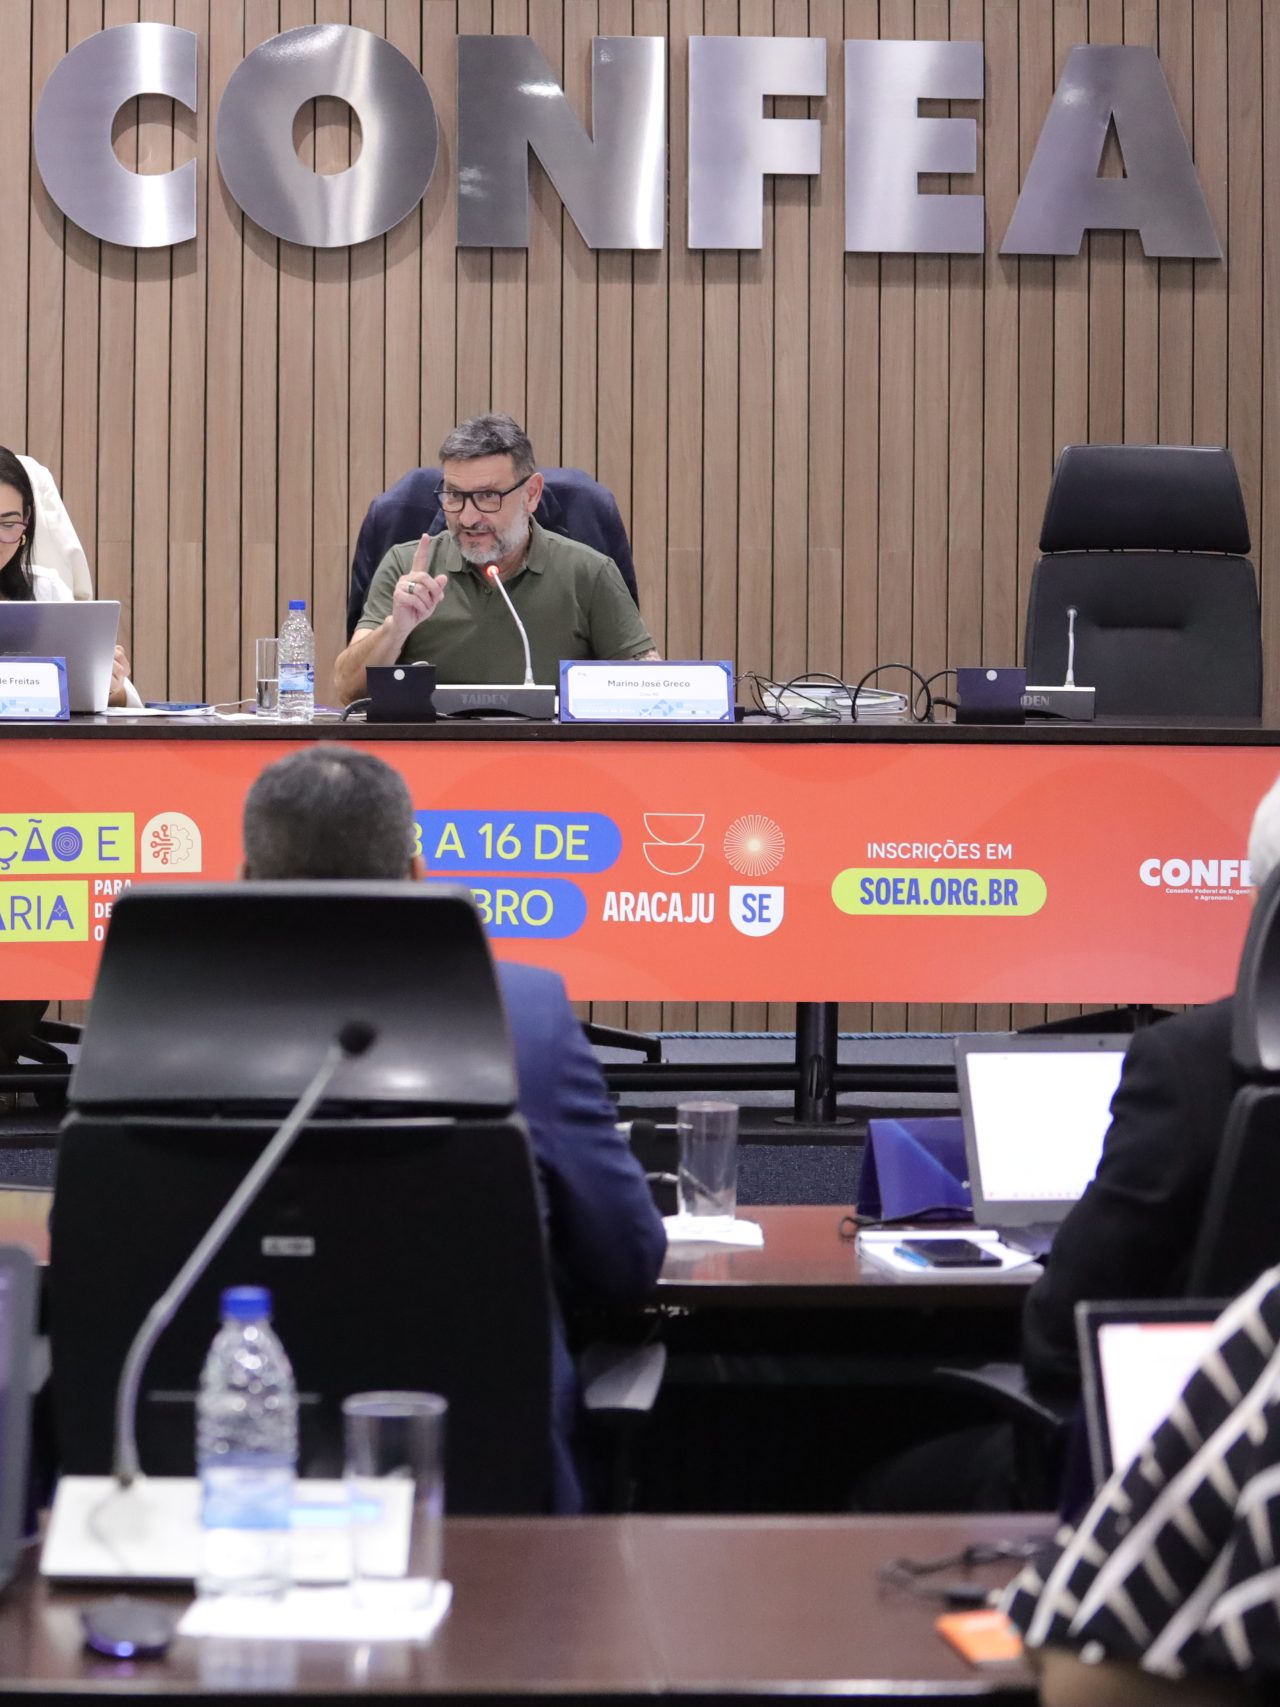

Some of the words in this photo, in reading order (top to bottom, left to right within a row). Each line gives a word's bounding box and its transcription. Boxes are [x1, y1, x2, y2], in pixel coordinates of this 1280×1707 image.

[34, 22, 1223, 258] CONFEA
[9, 677, 40, 685] Freitas
[607, 680, 639, 688] Marino
[641, 679, 661, 688] José
[663, 680, 691, 688] Greco
[461, 693, 511, 706] TAIDEN
[97, 826, 120, 861] E
[434, 822, 466, 859] A
[478, 823, 522, 860] 16
[534, 824, 590, 861] DE
[867, 839, 981, 862] INSCRIÇÕES
[986, 843, 1013, 860] EM
[859, 877, 1019, 906] SOEA.ORG.BR
[602, 891, 715, 924] ARACAJU
[741, 893, 772, 923] SE
